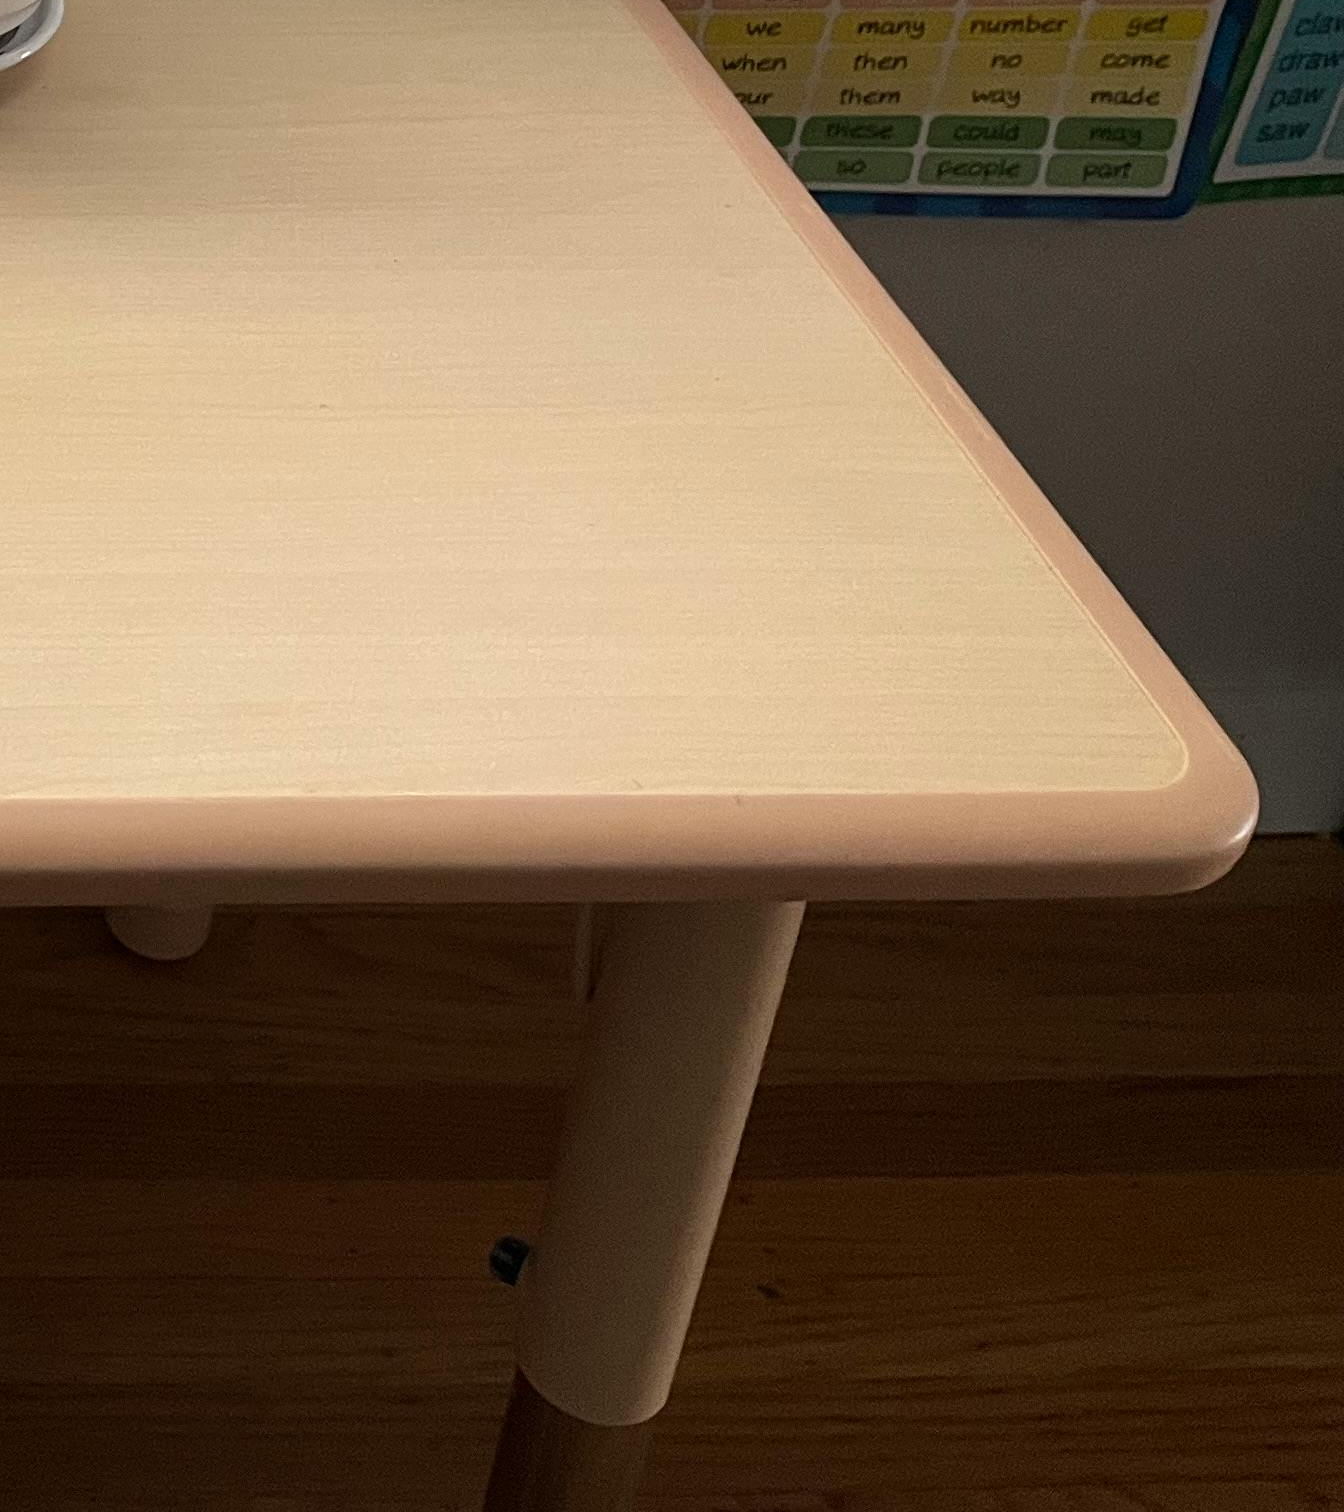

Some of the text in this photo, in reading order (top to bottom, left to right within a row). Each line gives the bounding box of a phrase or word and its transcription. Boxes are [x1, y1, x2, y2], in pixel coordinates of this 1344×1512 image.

[747, 15, 1168, 39] we many number get
[722, 53, 1170, 71] when then no come
[840, 87, 1160, 109] them way made
[1256, 123, 1310, 143] saw
